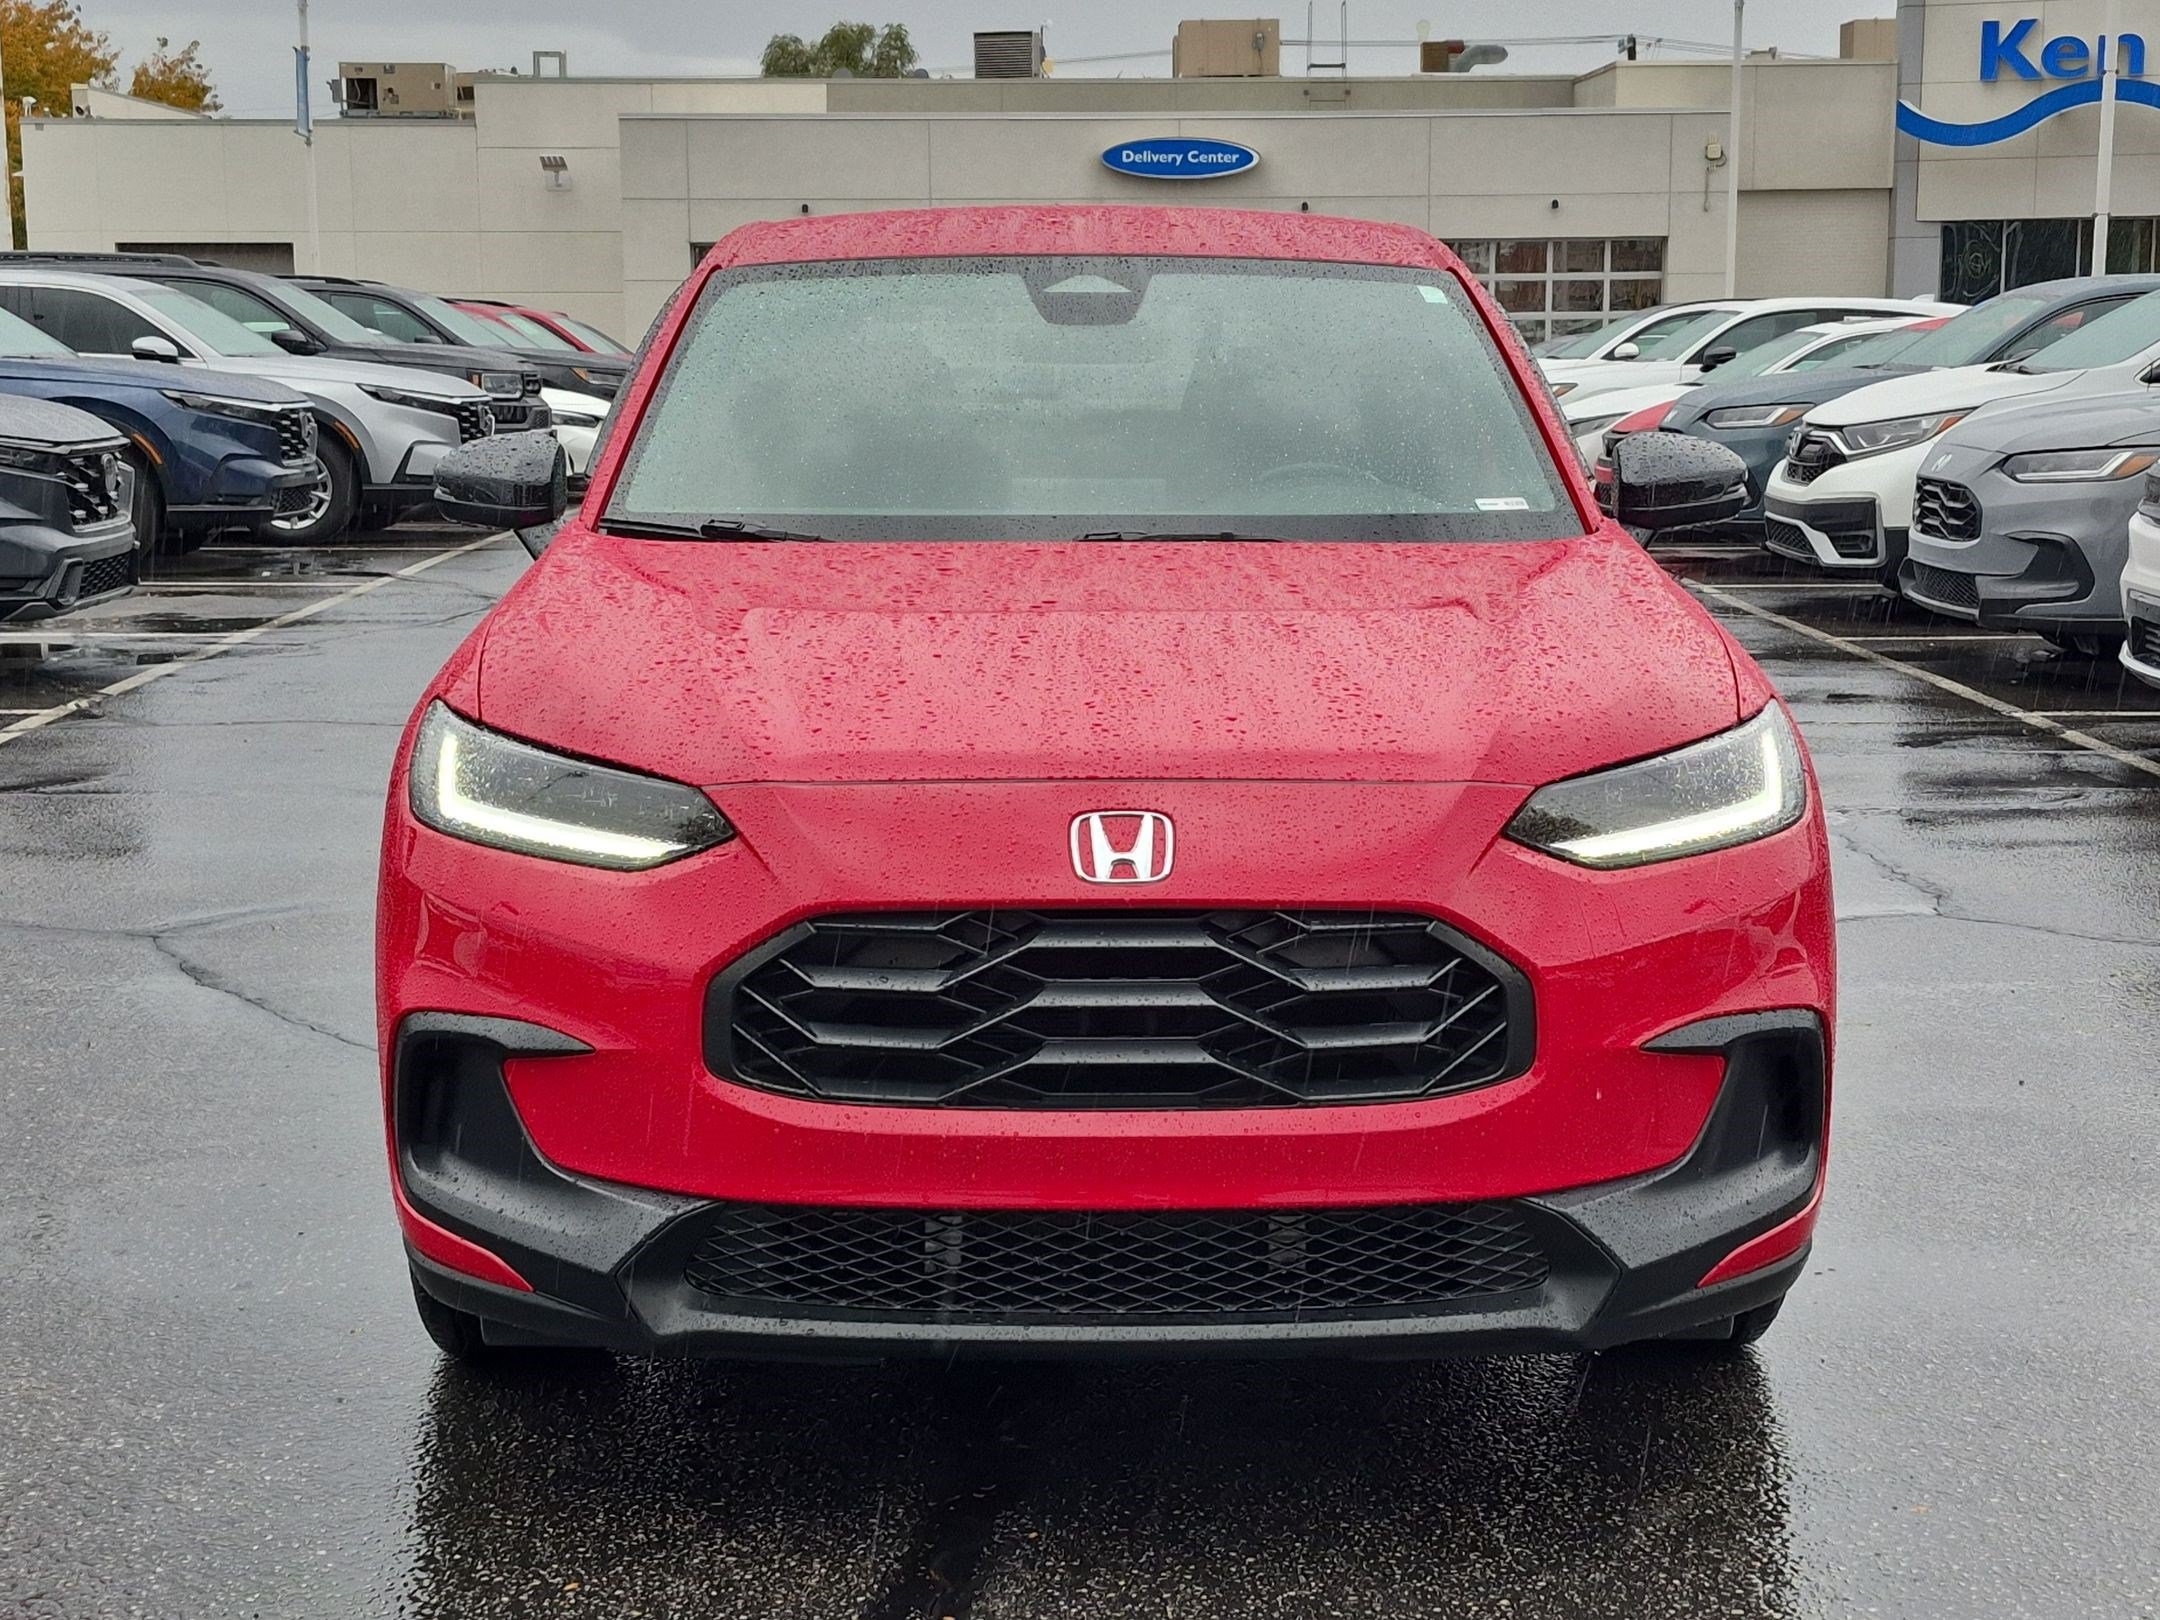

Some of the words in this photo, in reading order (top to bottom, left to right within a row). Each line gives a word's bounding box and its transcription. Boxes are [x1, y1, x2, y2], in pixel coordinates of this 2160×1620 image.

[1980, 18, 2145, 82] Ken
[1122, 150, 1183, 166] Delivery
[1187, 150, 1240, 163] Center
